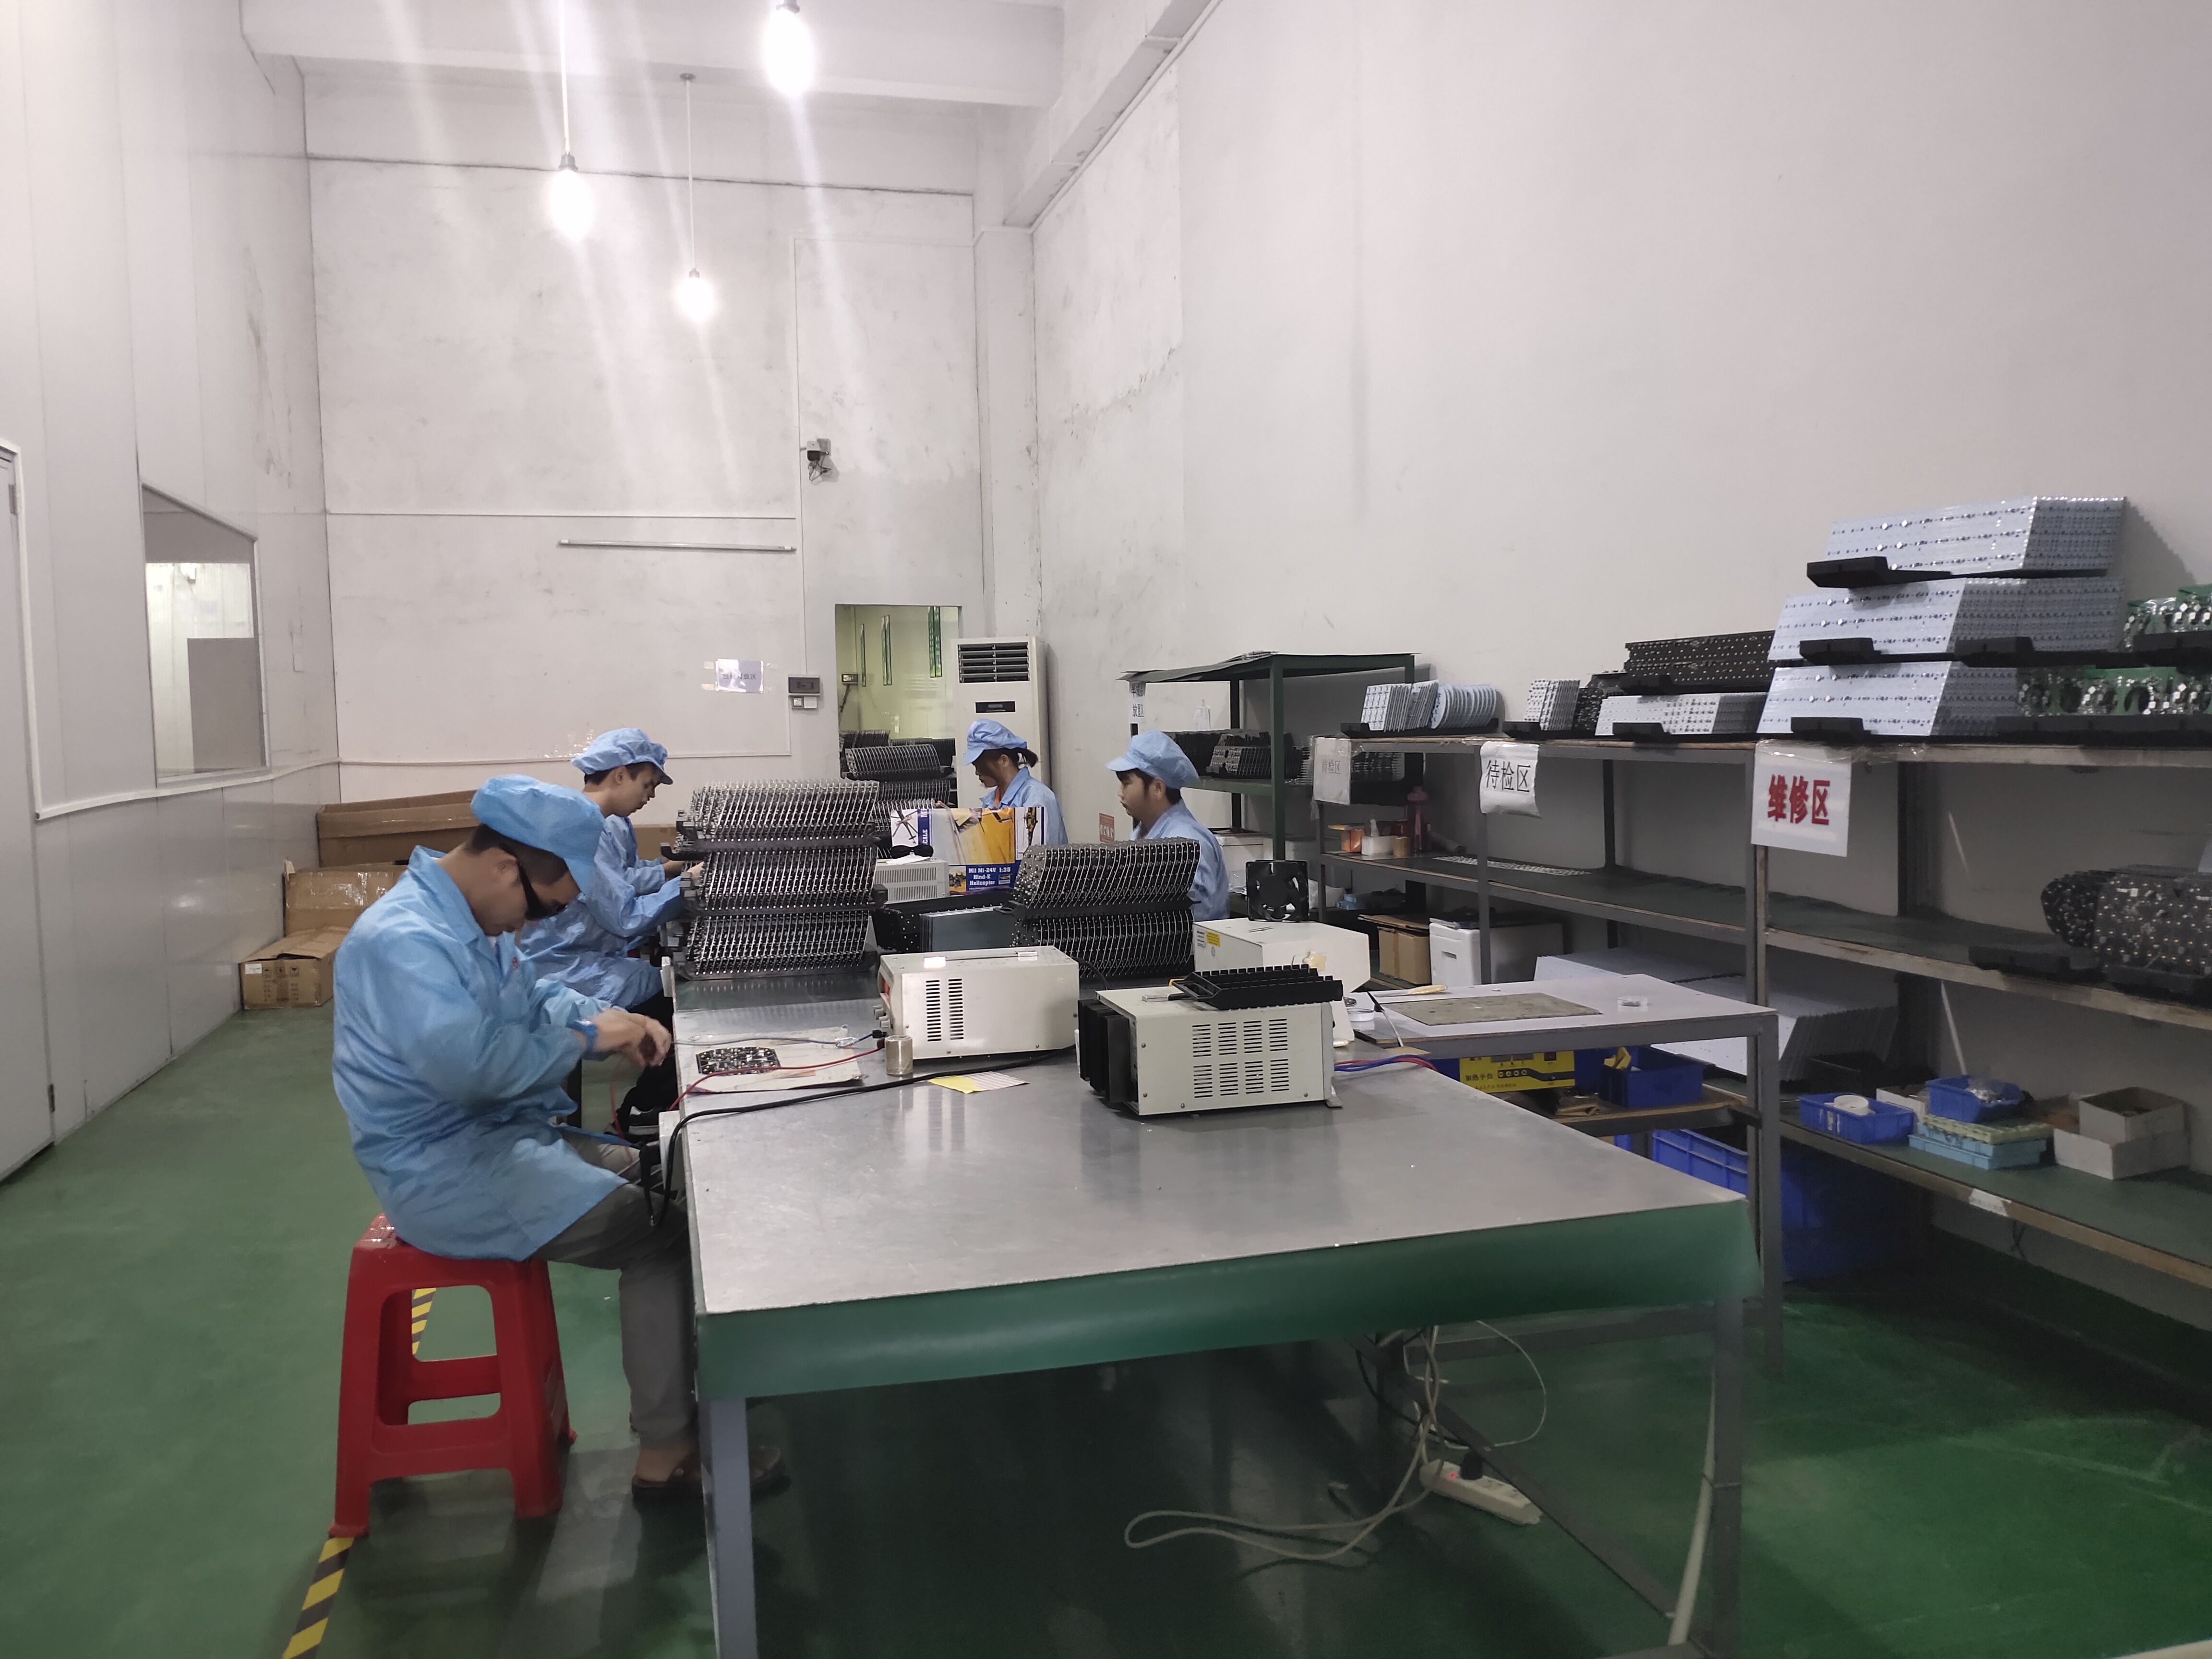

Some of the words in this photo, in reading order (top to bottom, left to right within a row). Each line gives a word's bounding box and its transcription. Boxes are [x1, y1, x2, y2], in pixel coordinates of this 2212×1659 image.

[1485, 759, 1531, 793] 待检区
[1767, 774, 1830, 826] 维修区
